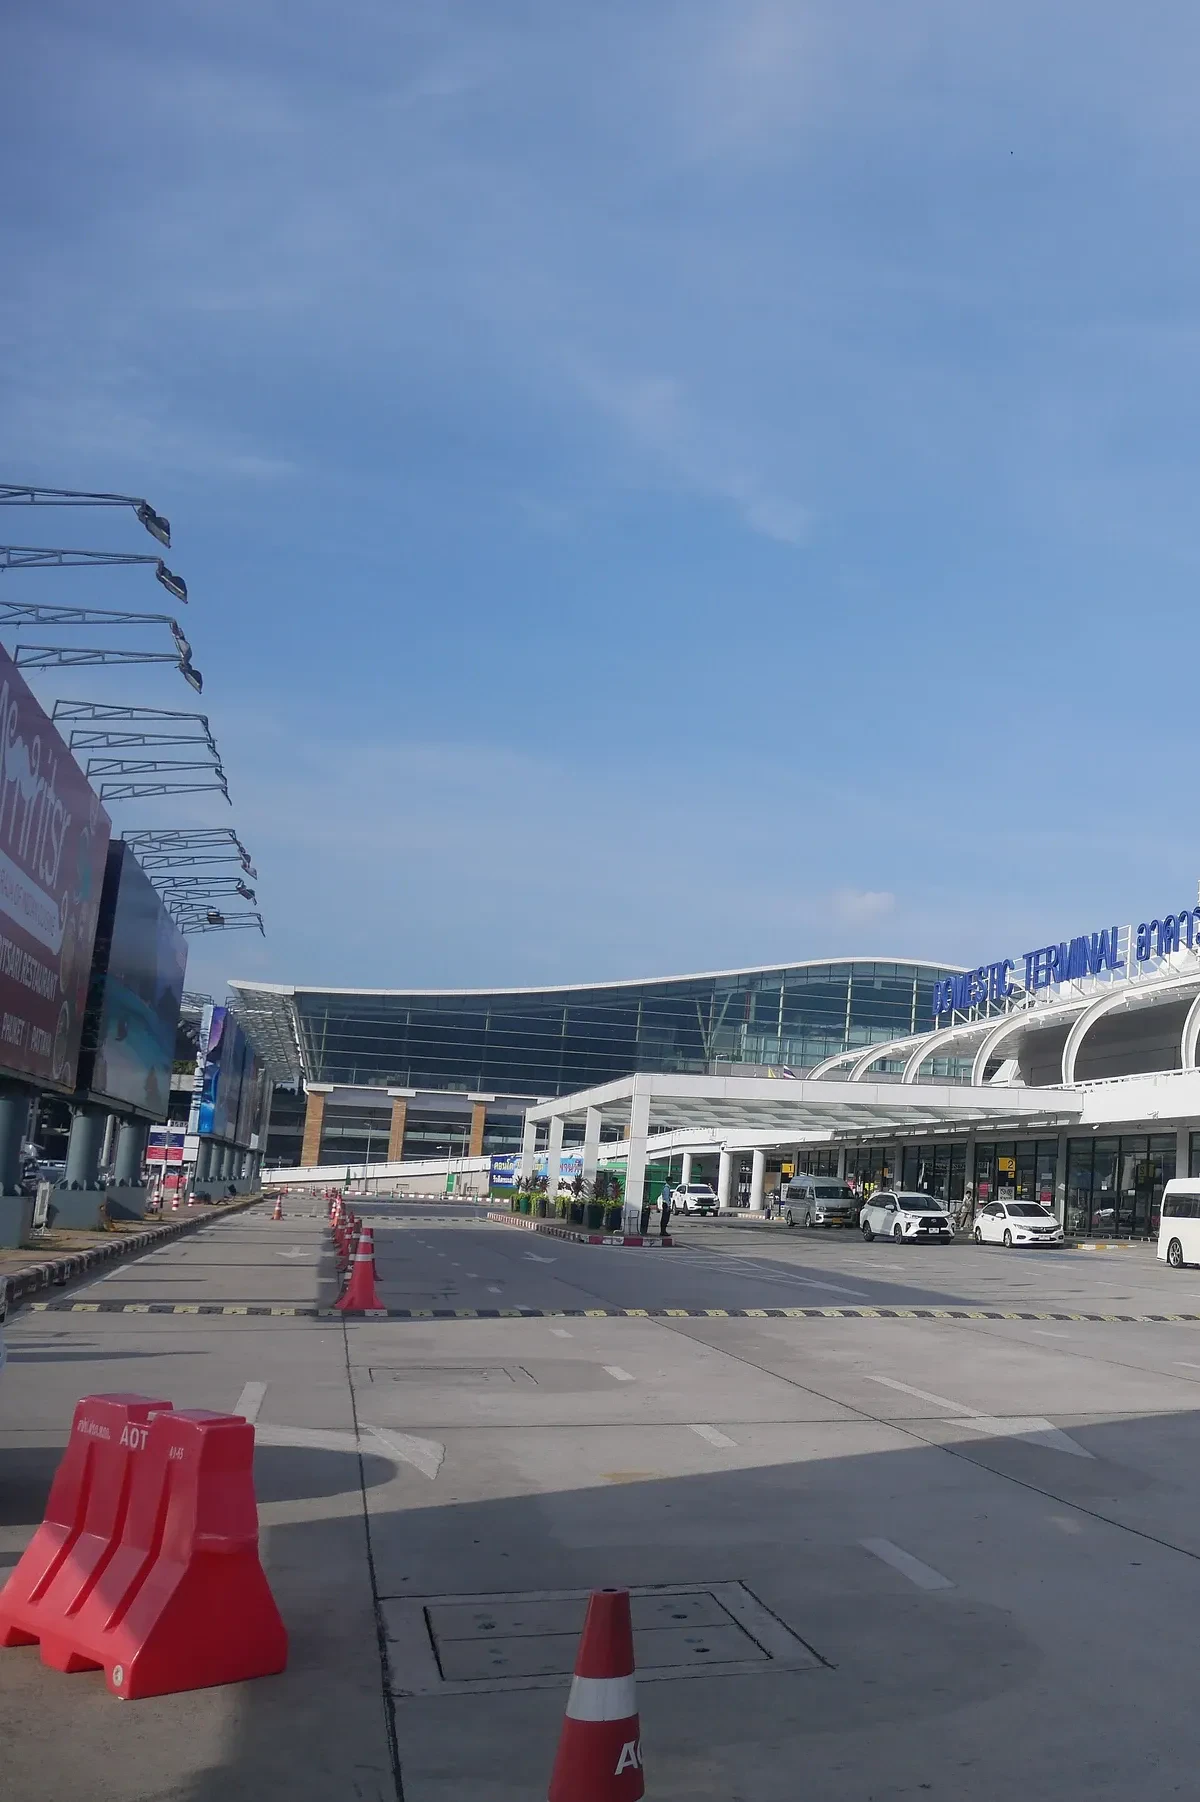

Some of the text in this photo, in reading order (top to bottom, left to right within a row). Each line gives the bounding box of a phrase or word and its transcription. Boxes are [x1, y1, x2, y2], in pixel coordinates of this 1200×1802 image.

[932, 926, 1124, 1015] DOMESTIC TERMINAL
[1007, 1160, 1014, 1169] 2
[119, 1425, 149, 1450] AOT
